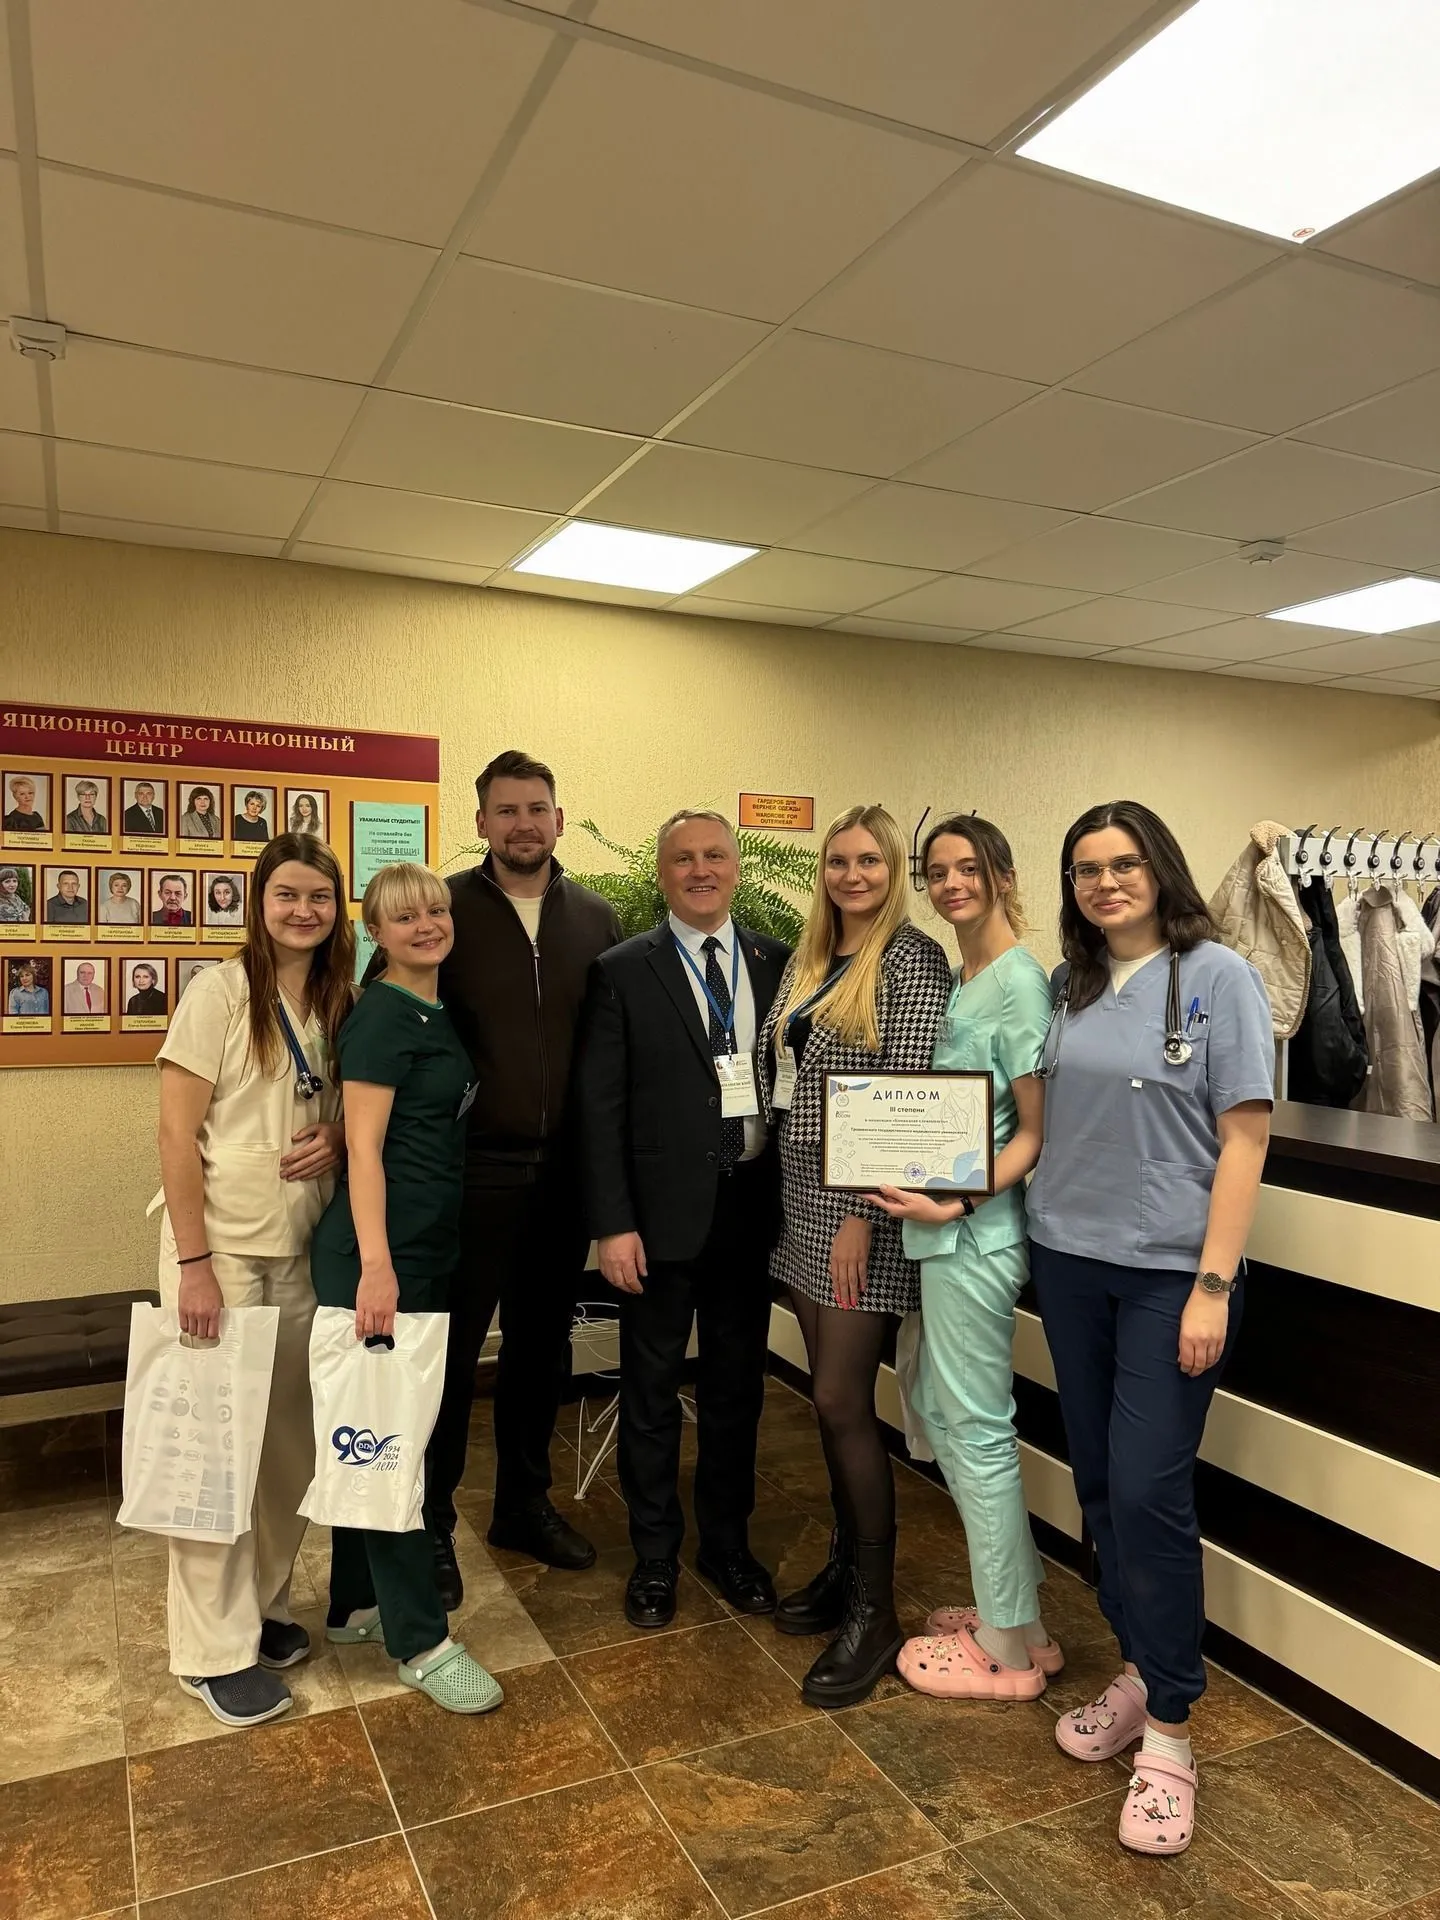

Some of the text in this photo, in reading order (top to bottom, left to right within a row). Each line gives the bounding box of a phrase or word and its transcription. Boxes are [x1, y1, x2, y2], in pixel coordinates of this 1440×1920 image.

[3, 713, 355, 752] ЯЦИОННО-АТТЕСТАЦИОННЫЙ
[105, 739, 184, 758] ЦЕНТР
[873, 1090, 940, 1101] ДИПЛОМ
[385, 1445, 401, 1453] 1934
[383, 1453, 399, 1461] 2024
